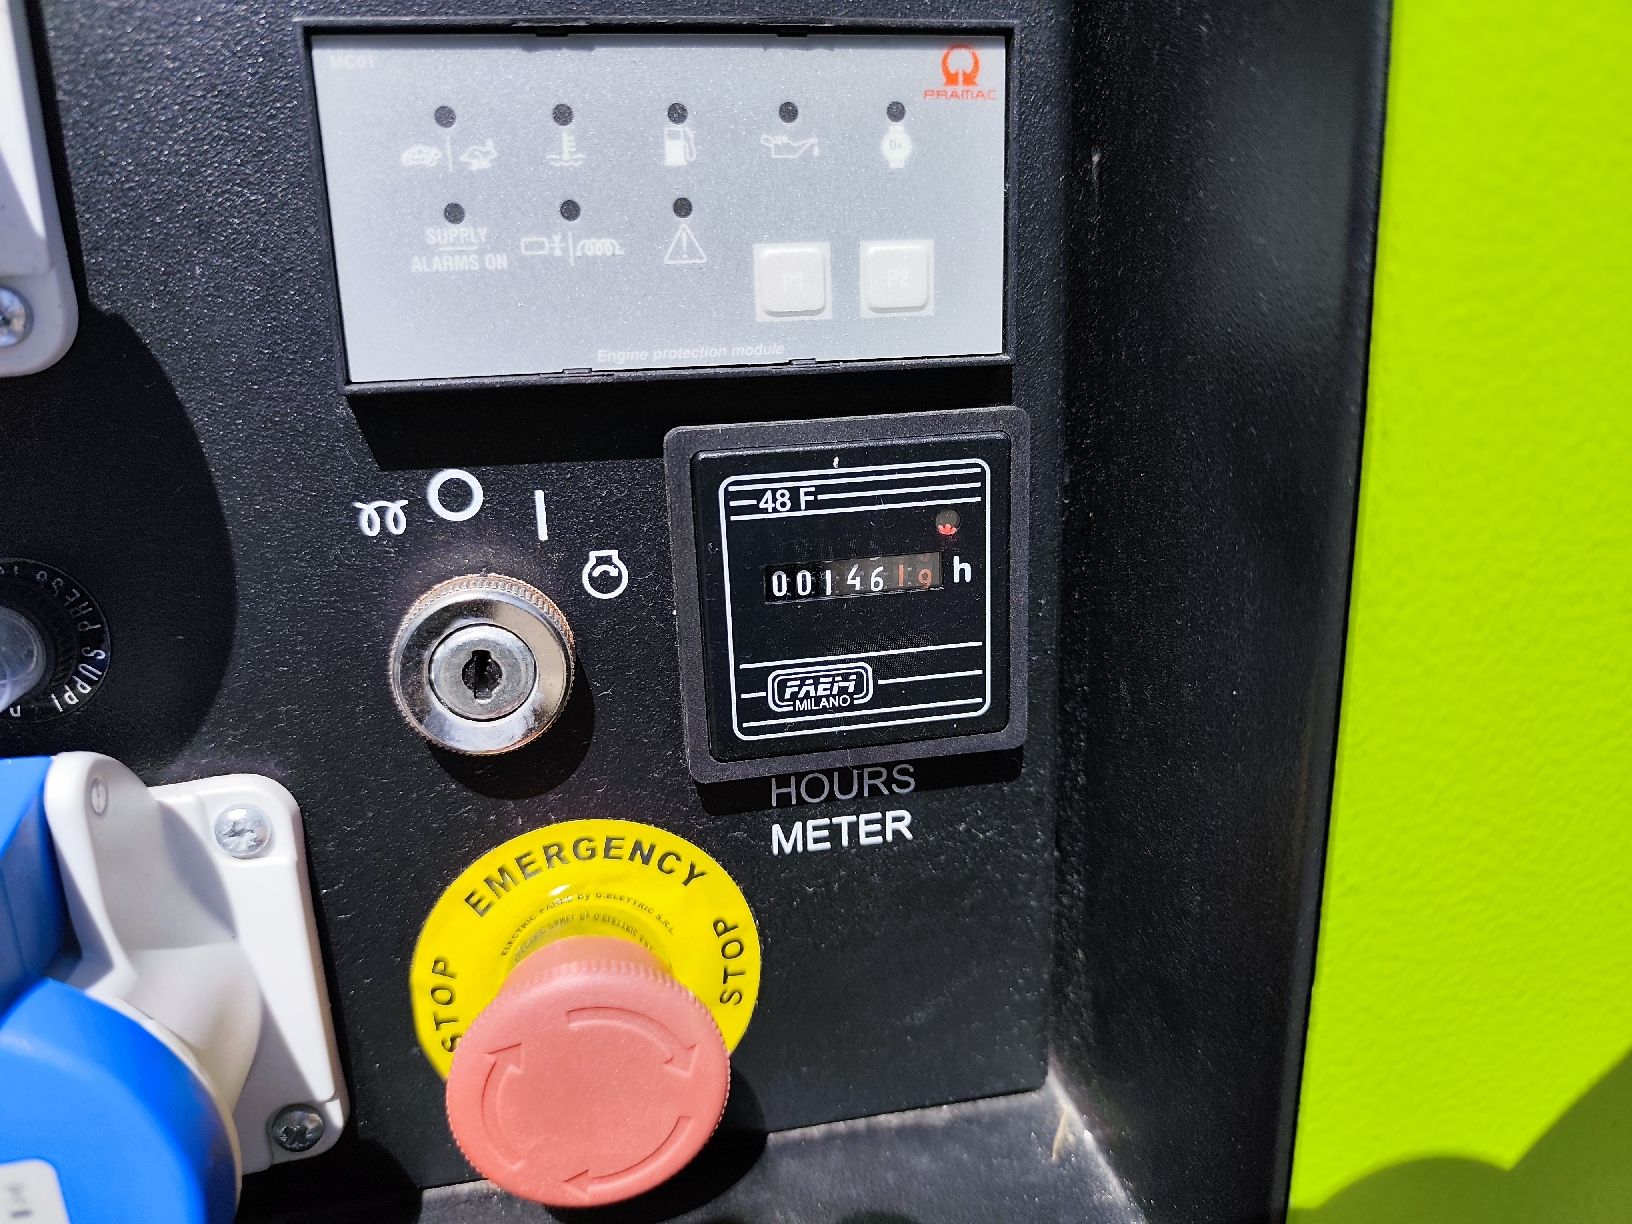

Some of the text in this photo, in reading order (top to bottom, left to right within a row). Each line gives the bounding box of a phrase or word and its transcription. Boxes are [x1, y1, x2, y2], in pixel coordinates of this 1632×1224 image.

[923, 89, 997, 100] PRAMAC
[425, 227, 488, 246] SUPPLY
[411, 253, 508, 273] ALARMS ON
[596, 342, 785, 364] Engine protection module
[758, 487, 816, 513] 48 F
[952, 555, 972, 584] h
[784, 674, 857, 699] FAEM
[795, 694, 851, 712] MILANO
[771, 763, 916, 808] HOURS
[771, 809, 914, 856] METER
[464, 834, 709, 918] EMERGENCY
[712, 916, 747, 1006] STOP
[430, 954, 463, 1053] STOP
